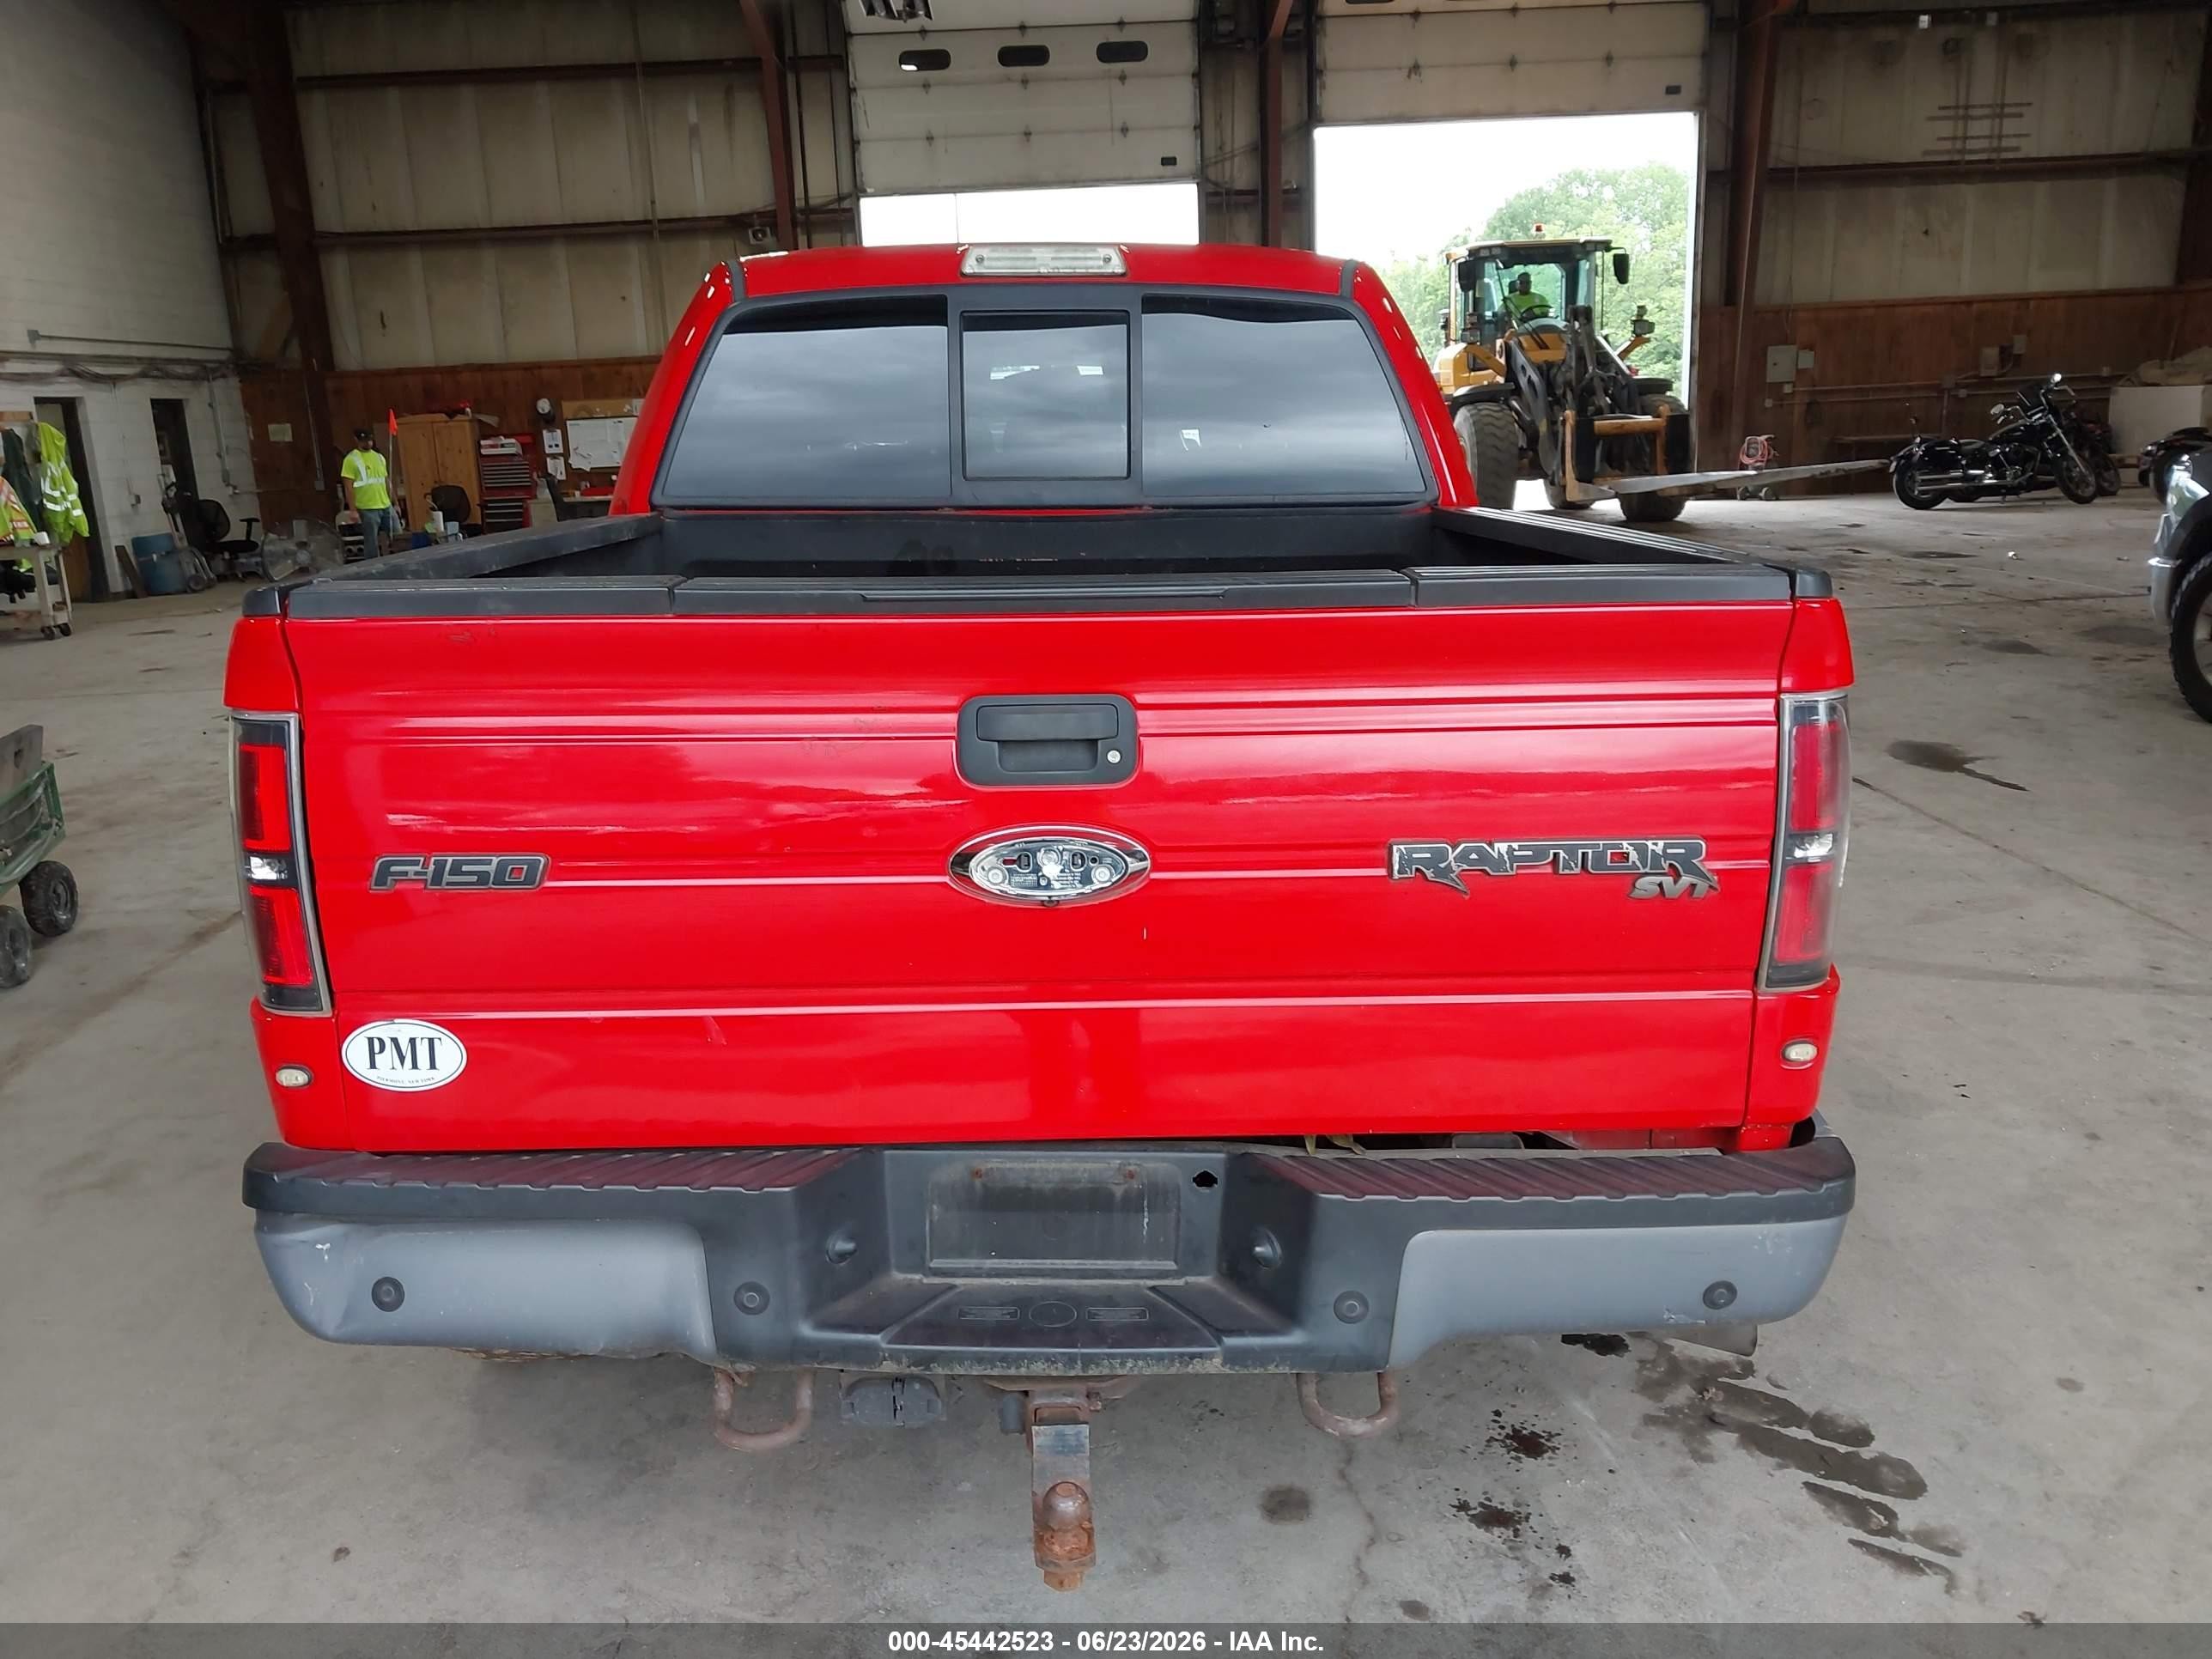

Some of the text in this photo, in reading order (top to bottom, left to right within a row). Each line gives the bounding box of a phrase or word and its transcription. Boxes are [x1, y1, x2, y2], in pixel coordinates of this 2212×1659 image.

[369, 854, 550, 891] F-150
[1388, 836, 1719, 896] RAPTOR
[1628, 875, 1715, 900] SVT
[364, 1036, 442, 1071] PMT
